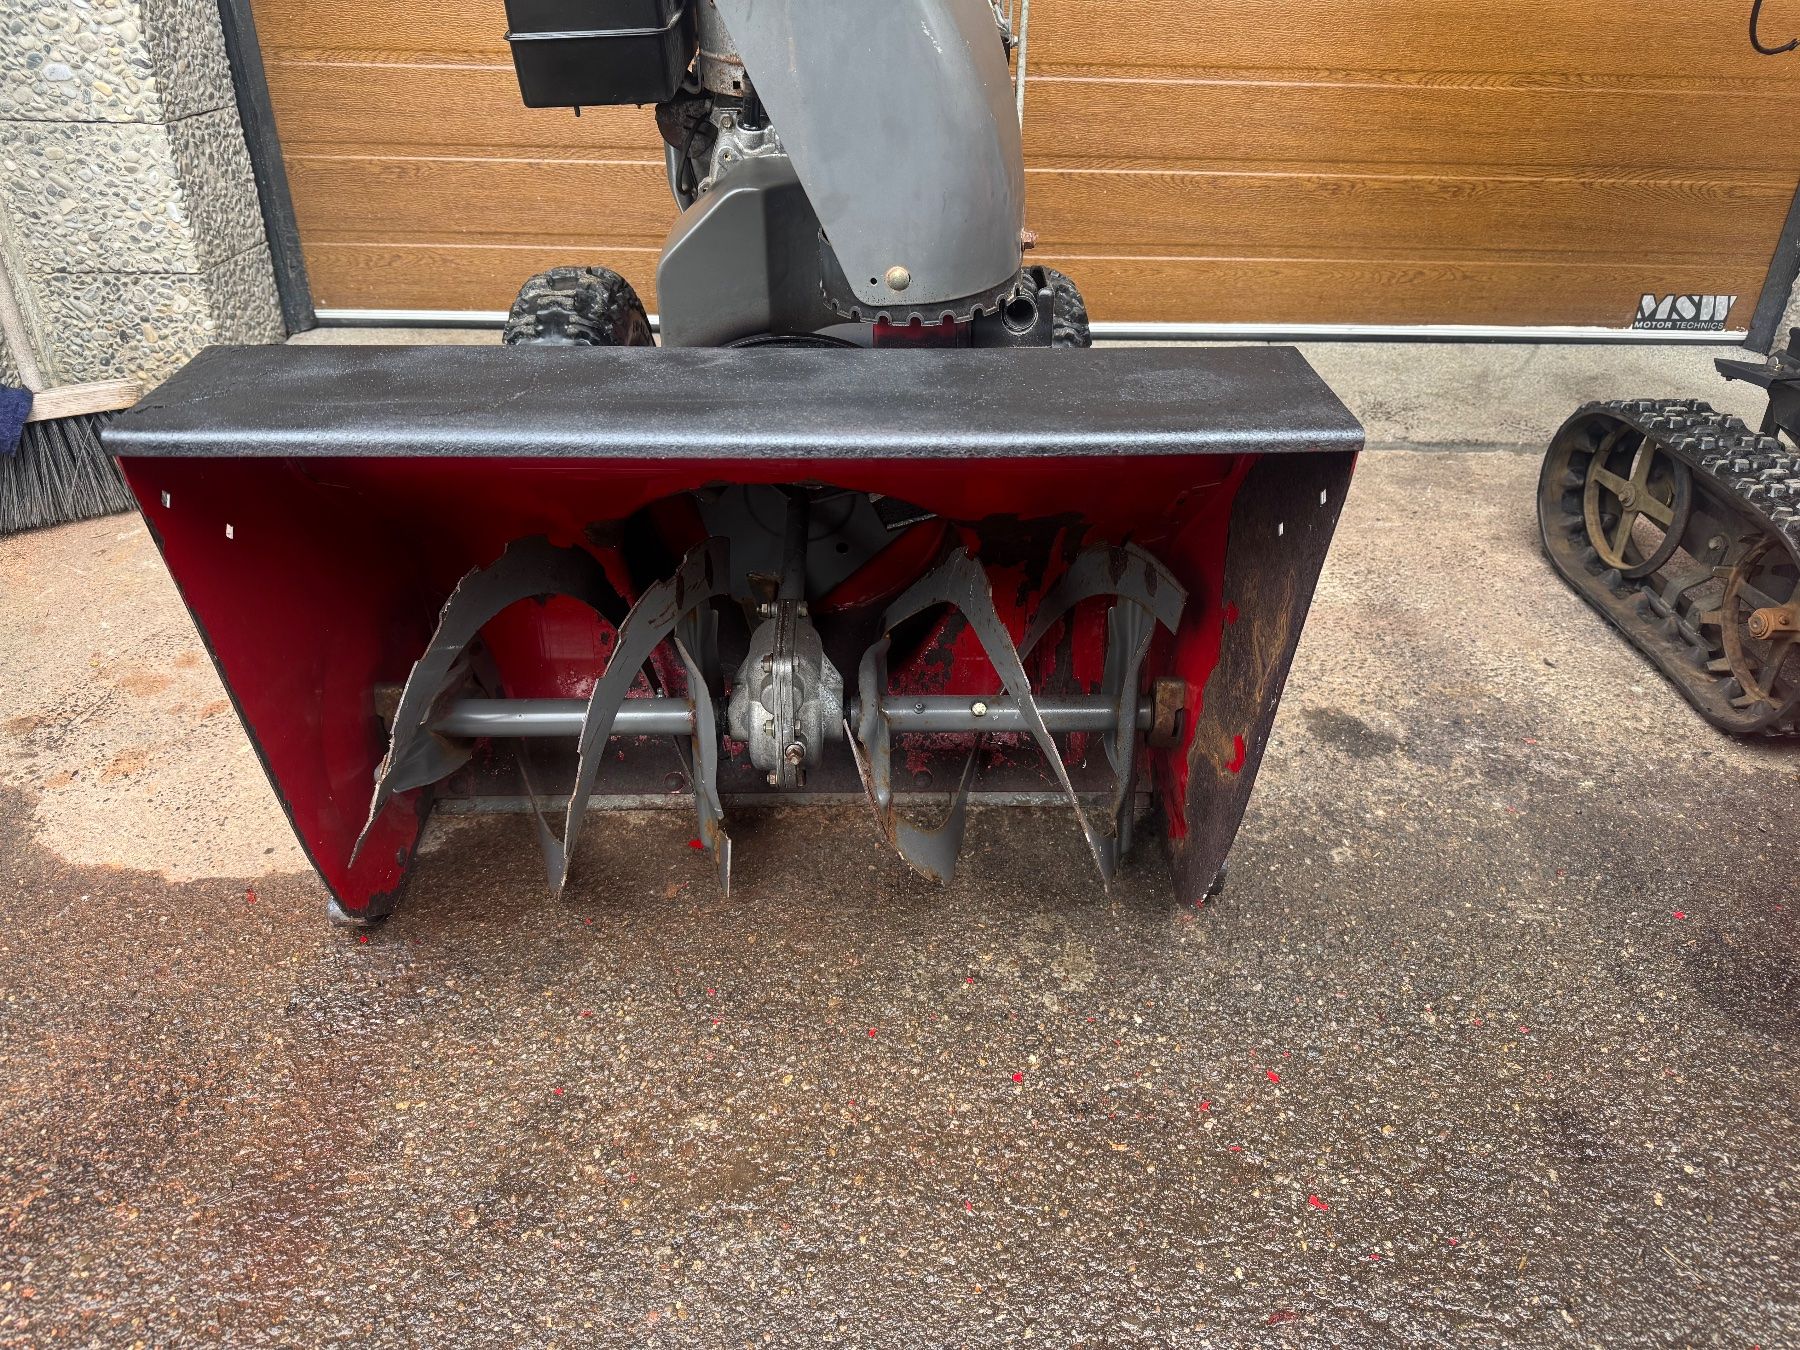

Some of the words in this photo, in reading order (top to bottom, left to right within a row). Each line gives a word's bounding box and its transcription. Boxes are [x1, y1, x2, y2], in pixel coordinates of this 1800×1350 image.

[1636, 294, 1738, 321] MSW
[1634, 320, 1672, 329] MOTOR
[1676, 321, 1724, 330] TECHNICS
